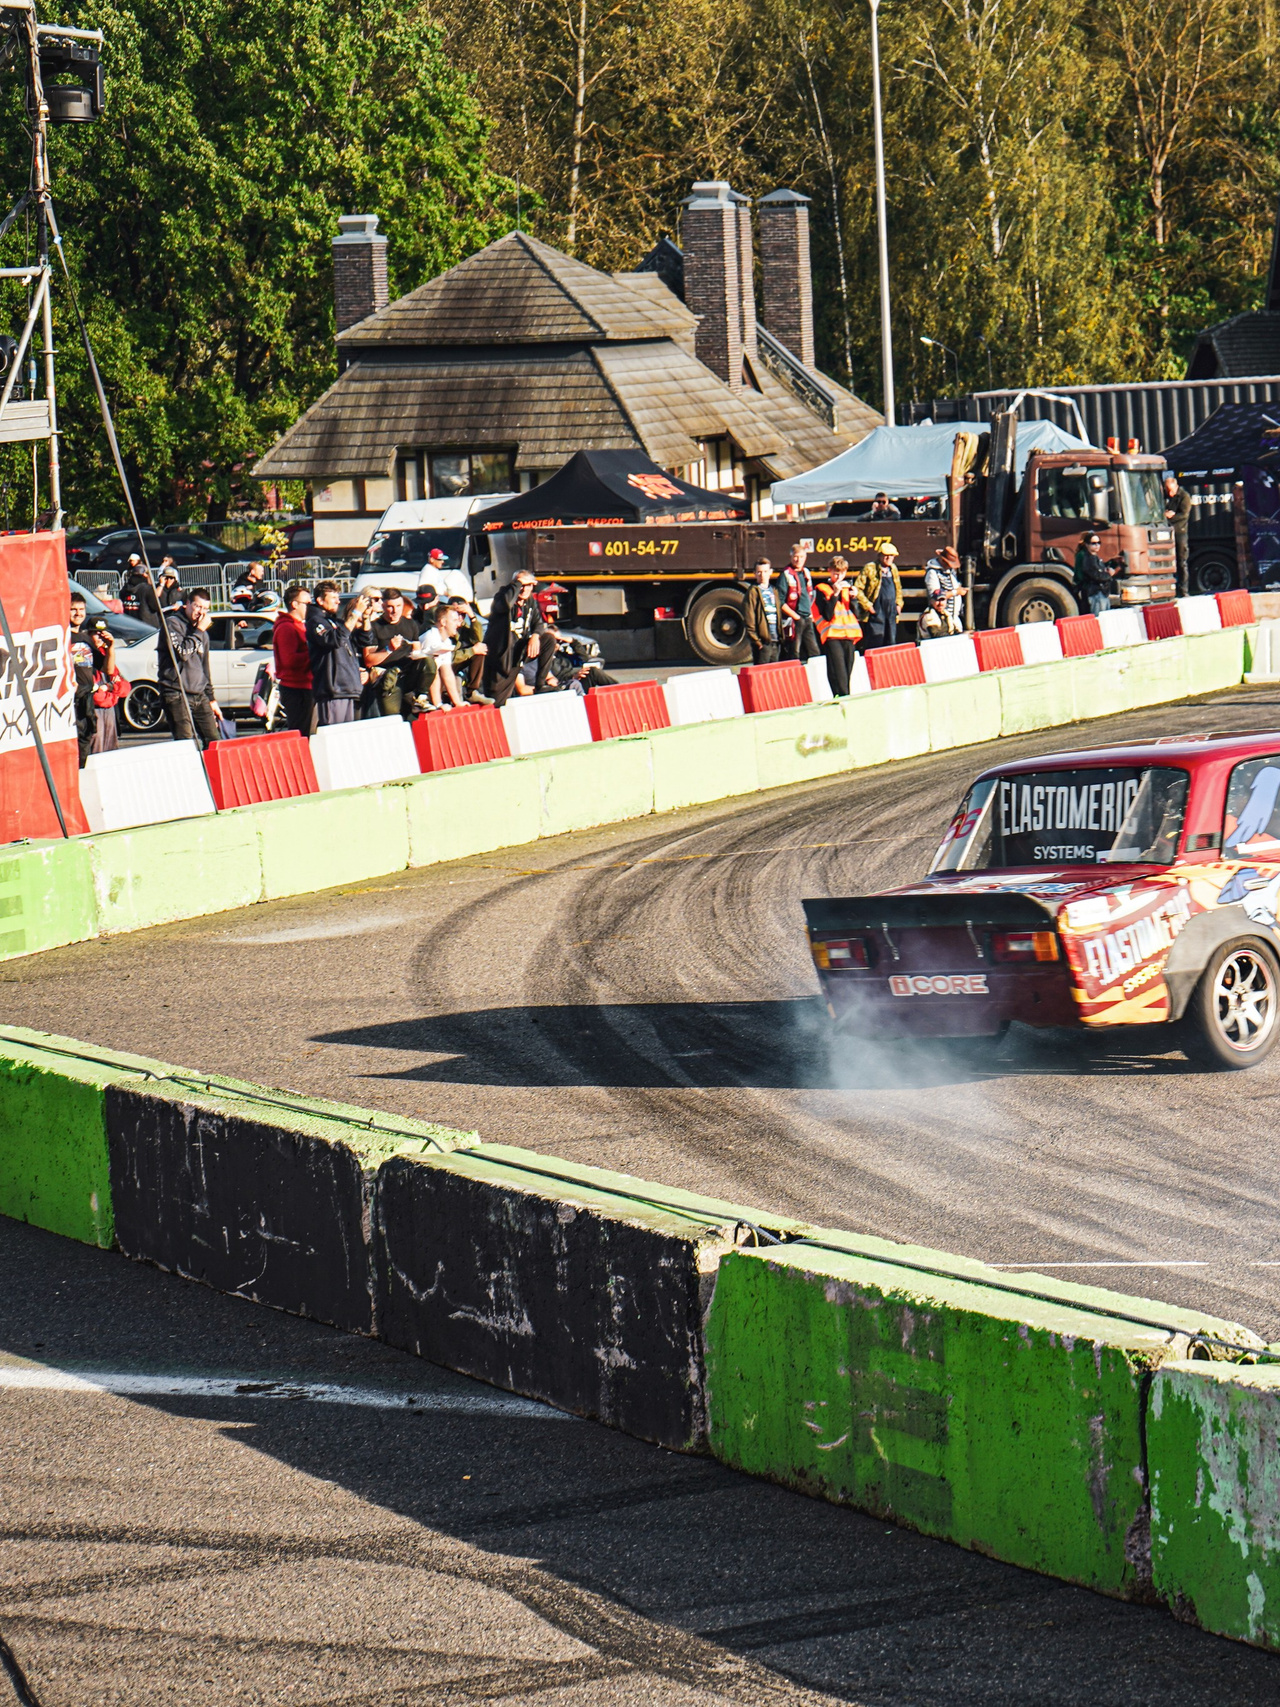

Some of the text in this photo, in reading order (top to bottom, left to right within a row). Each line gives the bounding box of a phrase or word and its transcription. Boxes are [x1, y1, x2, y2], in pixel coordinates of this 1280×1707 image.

[605, 540, 679, 556] 601-54-77
[1000, 778, 1139, 837] ELASTOMERIC
[1034, 845, 1095, 860] SYSTEMS
